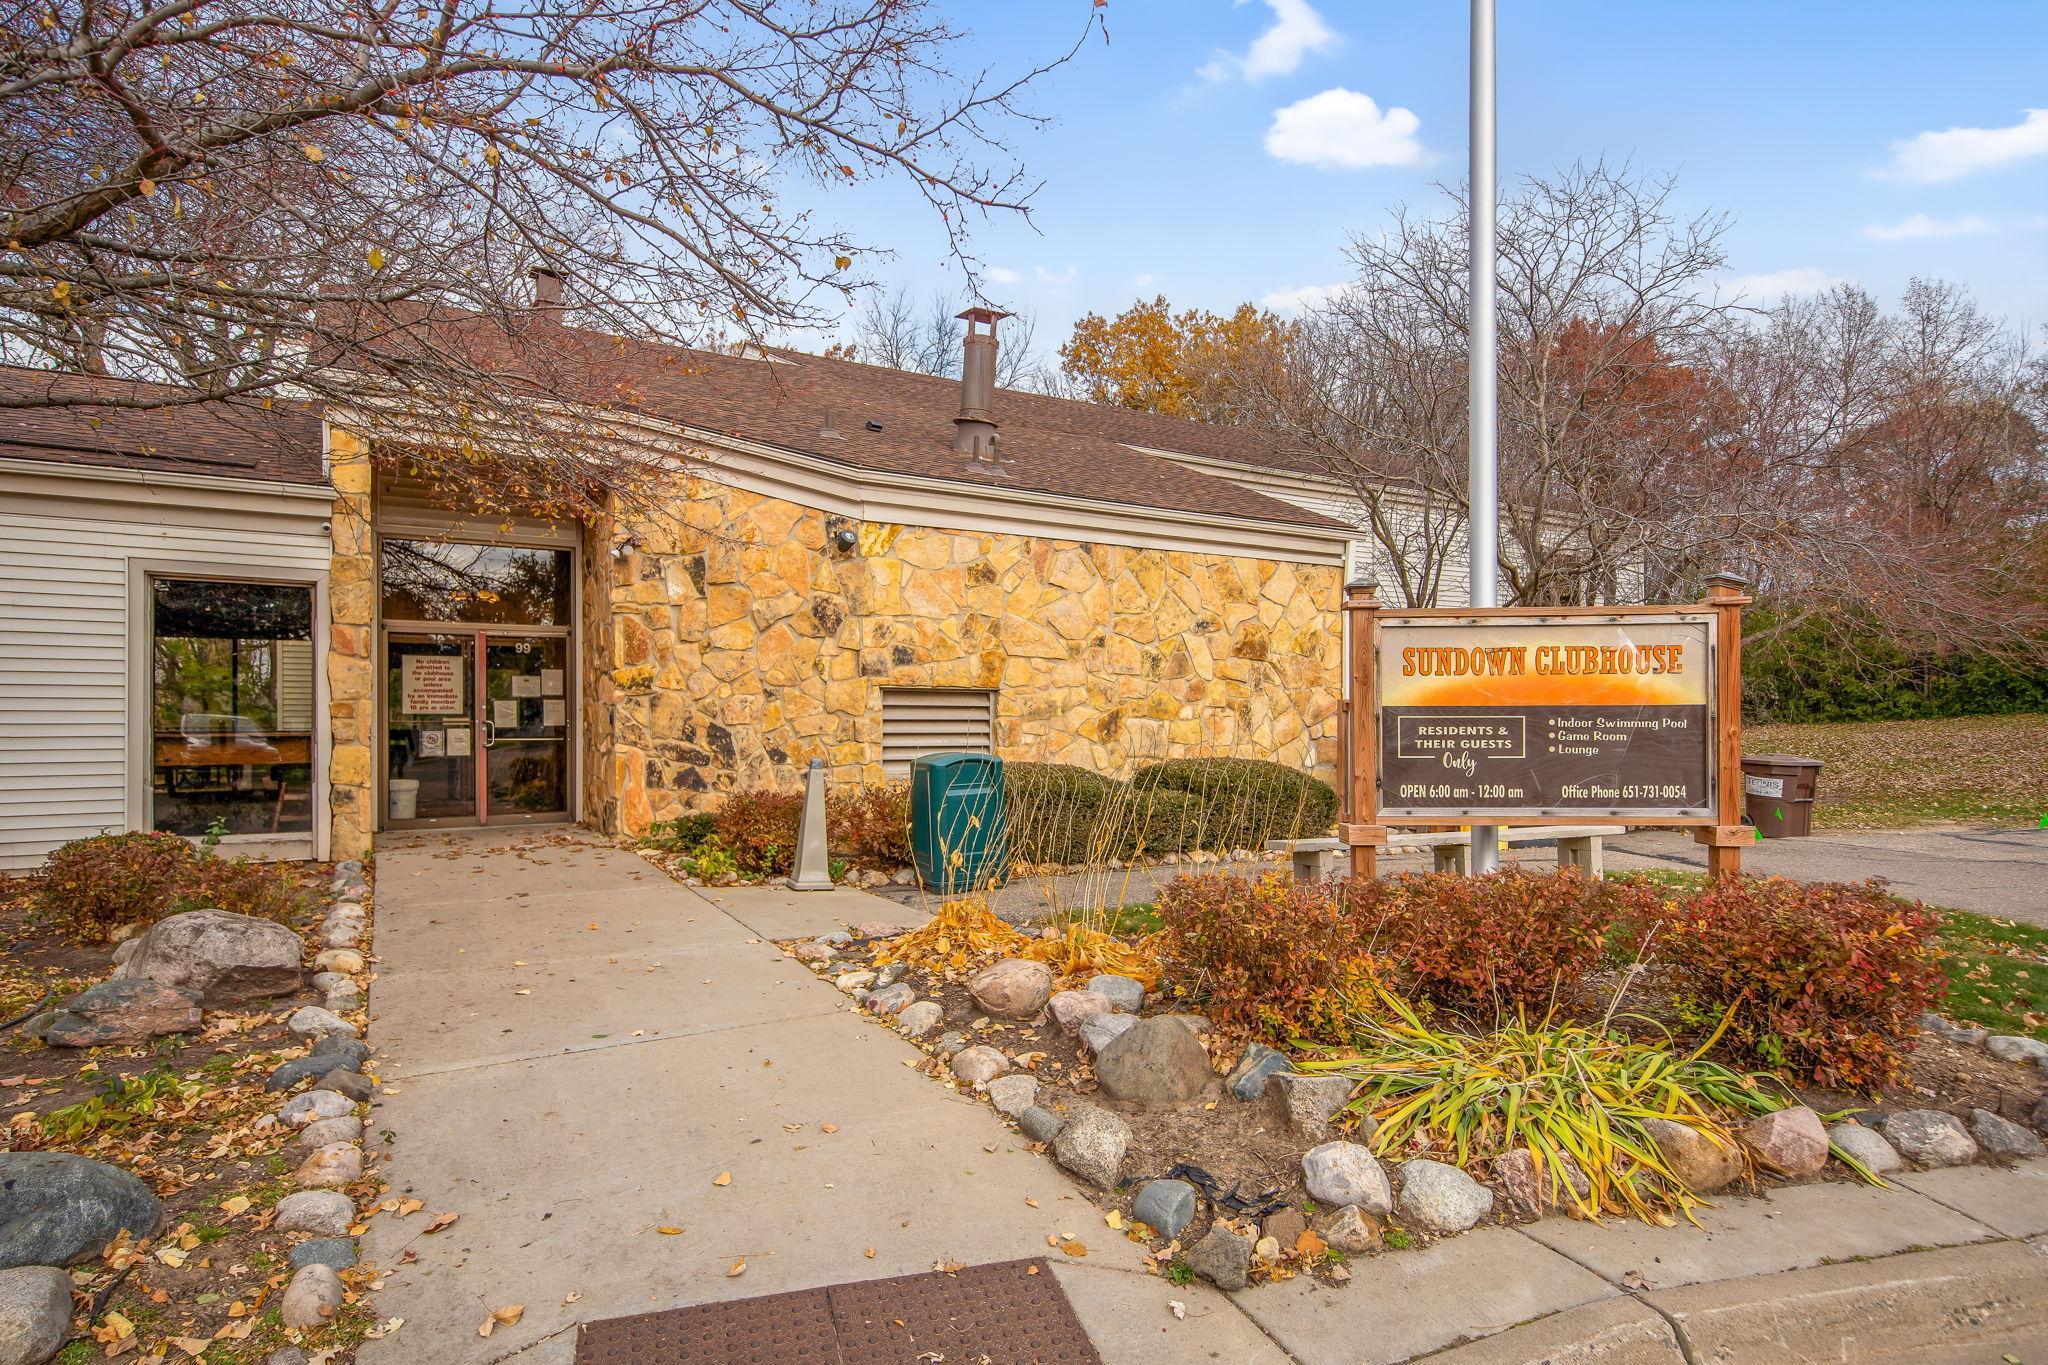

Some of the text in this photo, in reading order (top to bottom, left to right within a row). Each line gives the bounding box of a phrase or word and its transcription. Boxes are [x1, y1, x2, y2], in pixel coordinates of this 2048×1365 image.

[515, 643, 531, 654] 99
[1402, 645, 1683, 676] SUNDOWN CLUBHOUSE
[1557, 717, 1687, 730] Indoor Swimming Pool
[1418, 726, 1509, 735] RESIDENTS &
[1558, 730, 1627, 741] Game Room
[1415, 740, 1512, 749] THEIR GUESTS
[1558, 744, 1599, 756] Lounge
[1442, 751, 1477, 777] Only
[1400, 785, 1426, 798] OPEN
[1429, 785, 1450, 798] 6:00
[1453, 788, 1469, 798] am
[1478, 785, 1505, 798] 12:00
[1508, 788, 1524, 798] am
[1561, 785, 1687, 799] Office Phone 651-731-0054
